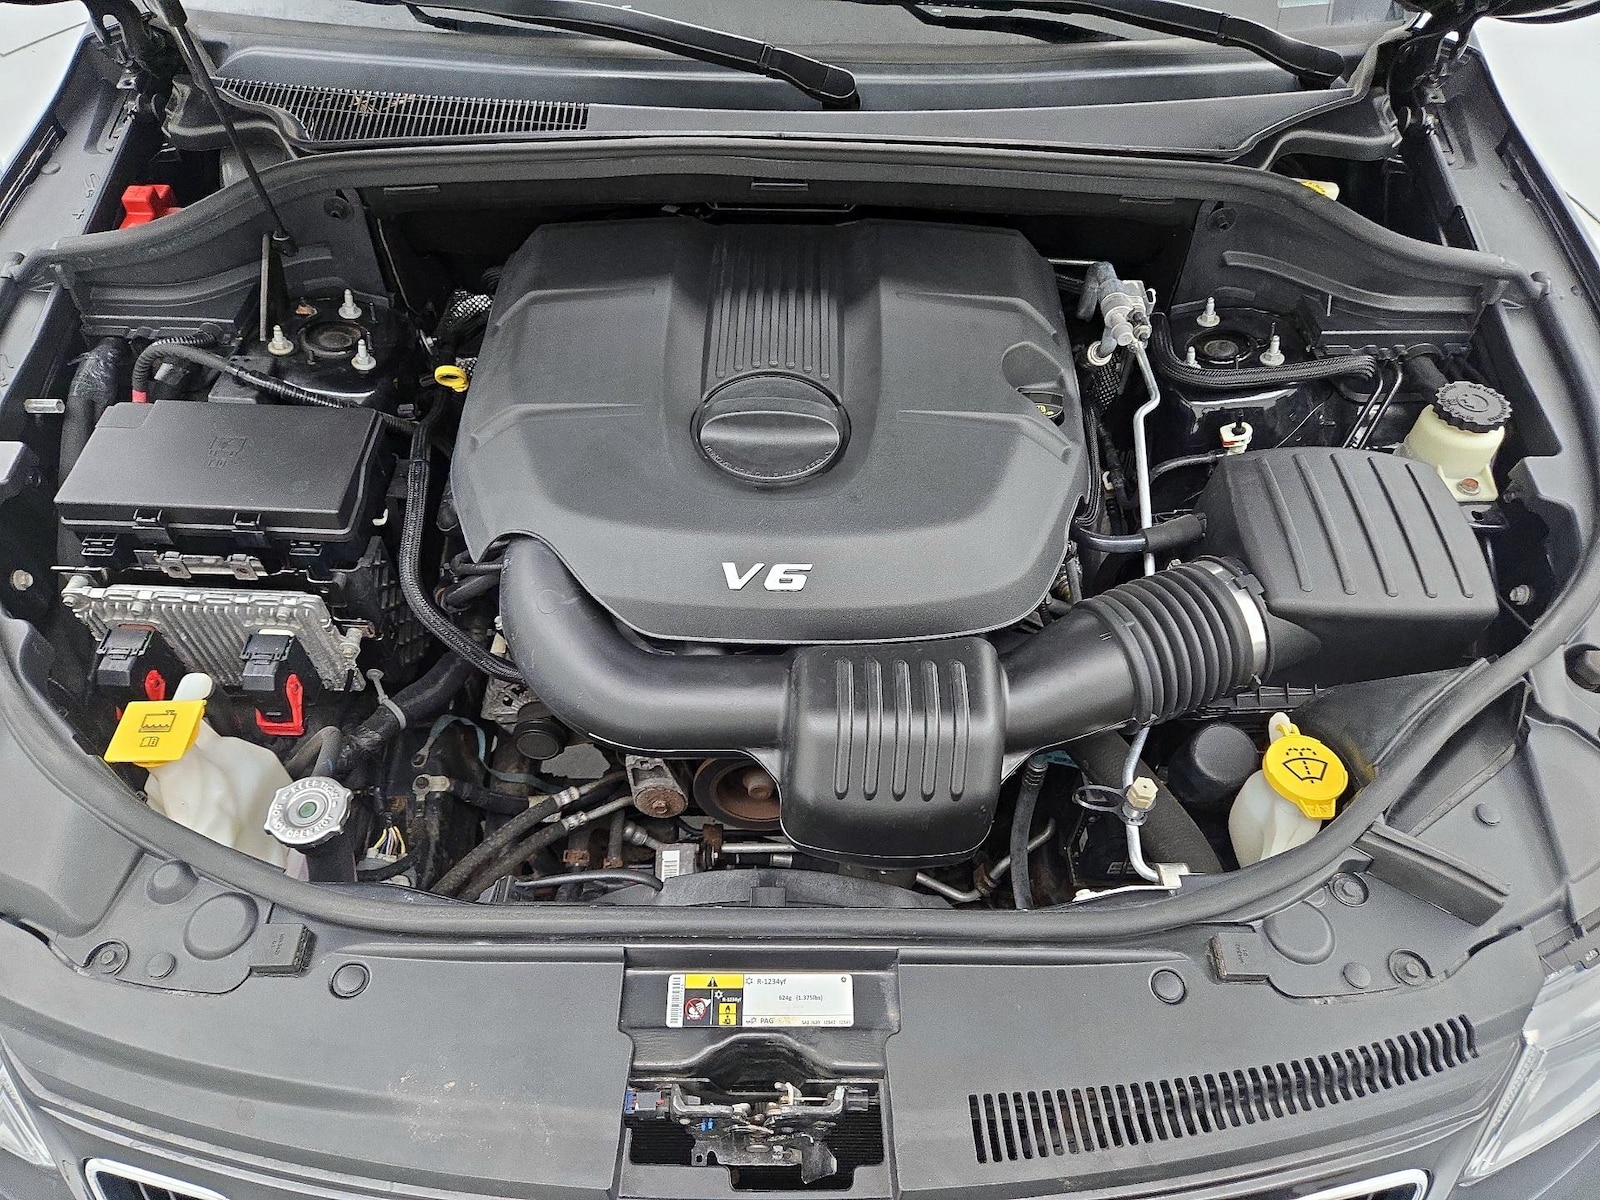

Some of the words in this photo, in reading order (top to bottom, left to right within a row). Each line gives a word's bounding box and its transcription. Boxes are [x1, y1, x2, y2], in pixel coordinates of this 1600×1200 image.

[721, 561, 815, 592] V6
[756, 977, 787, 986] R-1234yf
[795, 994, 824, 1002] (1.375lbs)
